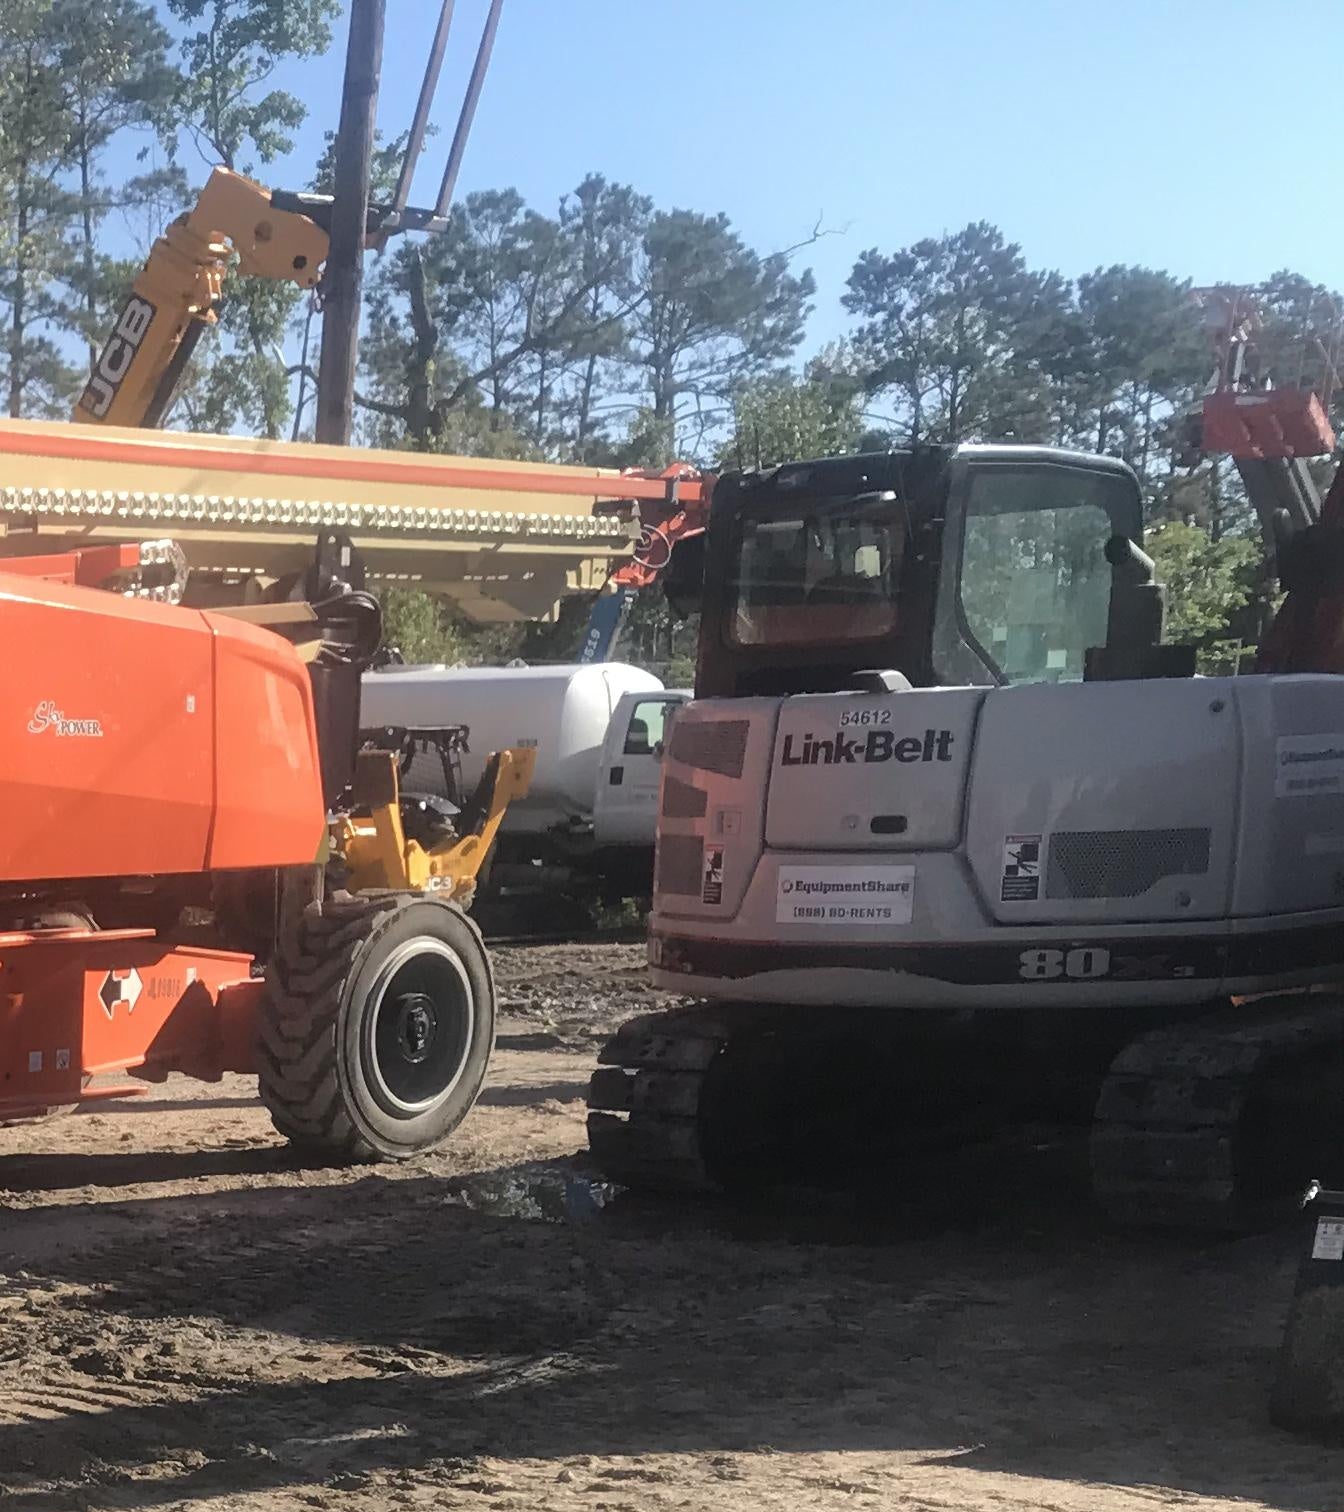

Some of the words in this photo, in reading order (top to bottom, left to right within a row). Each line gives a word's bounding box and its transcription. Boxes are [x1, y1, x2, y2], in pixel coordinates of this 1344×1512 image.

[91, 299, 153, 417] JCB
[840, 710, 892, 727] 54612
[781, 729, 955, 766] Link-Belt
[794, 879, 911, 895] EquipmentShare
[1018, 947, 1111, 979] 80
